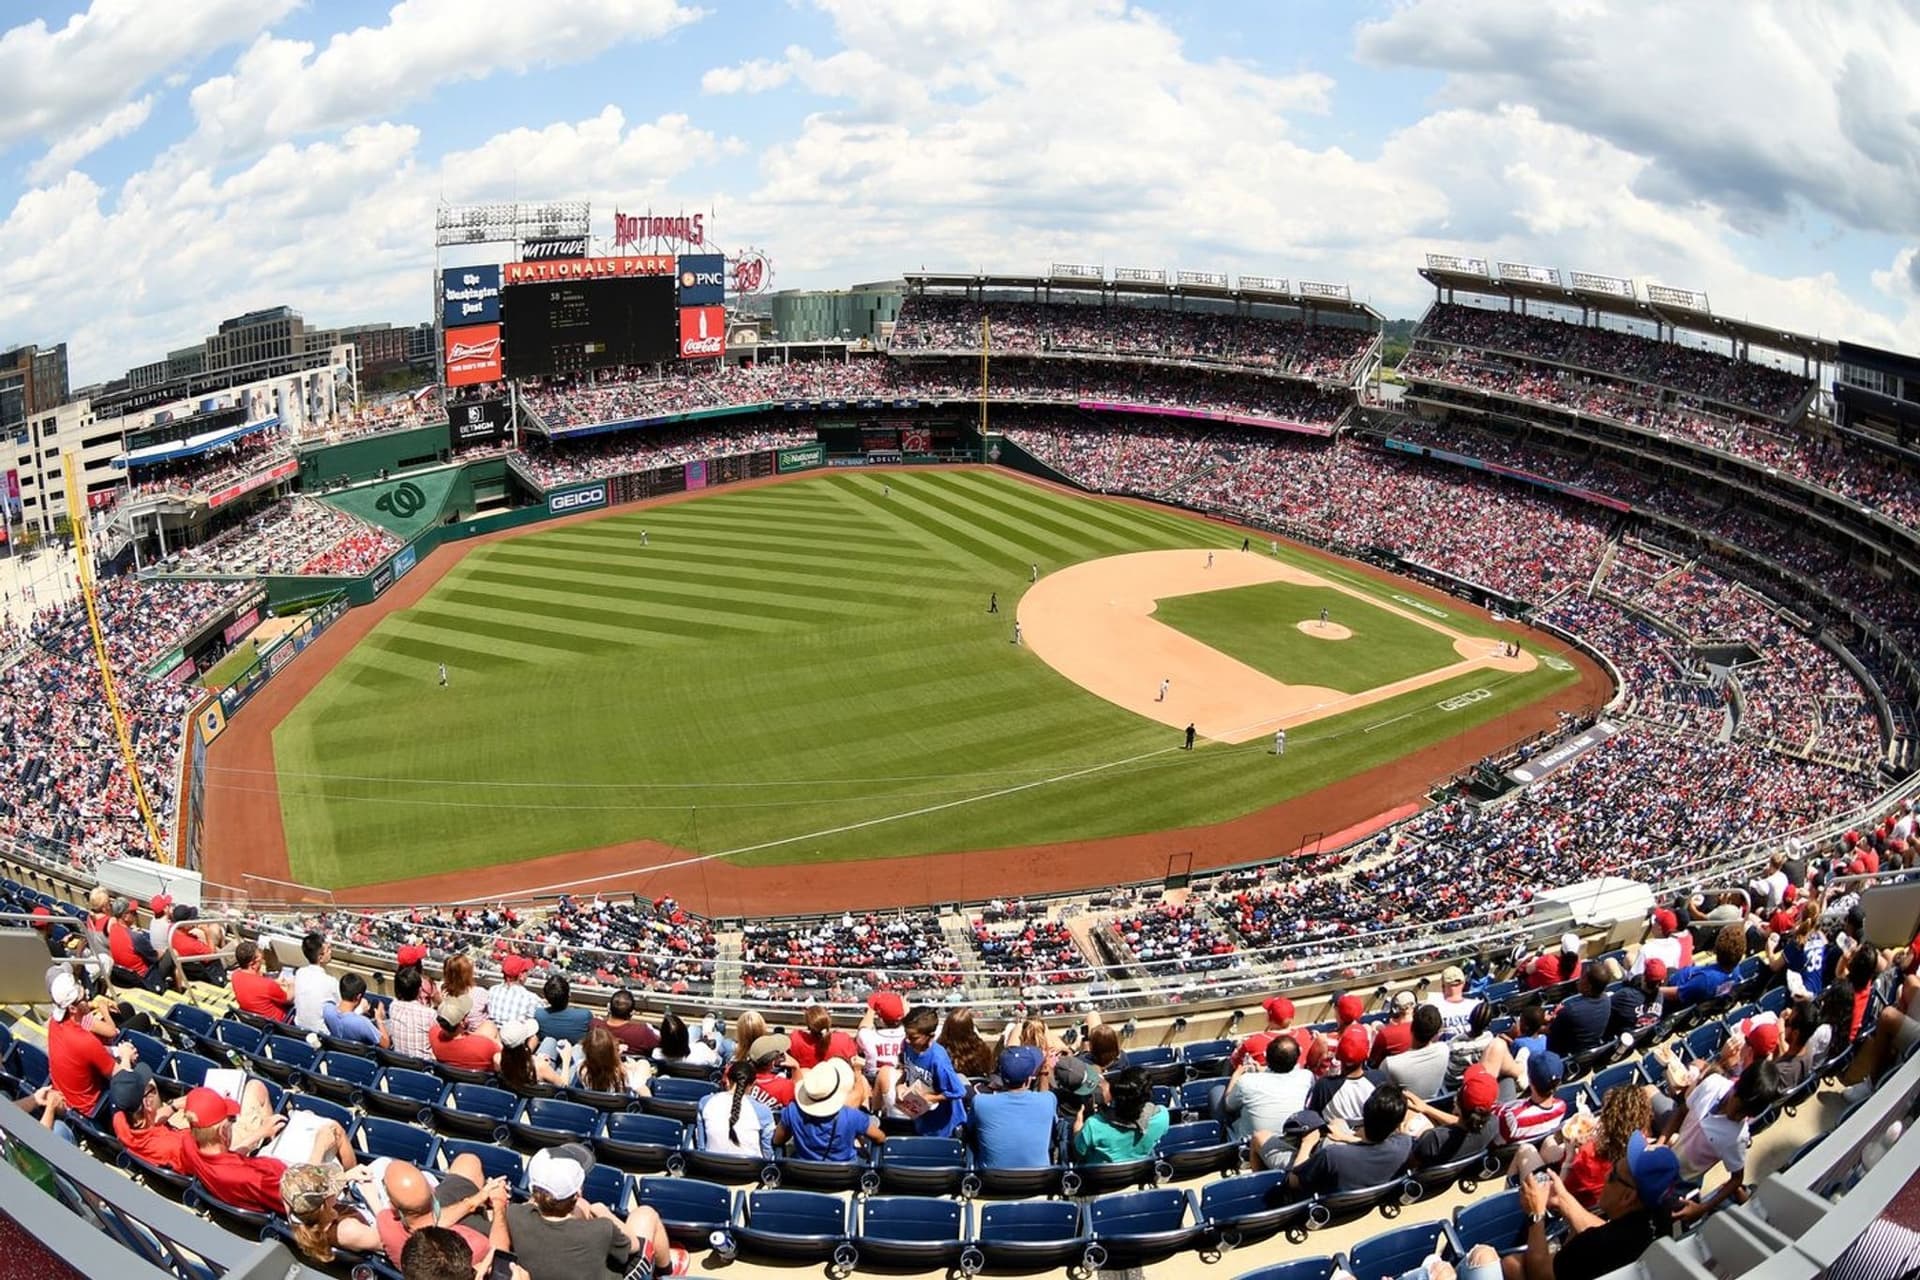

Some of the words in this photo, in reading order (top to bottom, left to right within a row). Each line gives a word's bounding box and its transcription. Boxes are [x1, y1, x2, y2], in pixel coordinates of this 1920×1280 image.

[615, 213, 704, 247] NATIONALS
[511, 261, 616, 278] NATIONALS
[624, 259, 667, 271] PARK
[463, 274, 480, 285] The
[697, 273, 723, 285] PNC
[446, 288, 498, 300] Washington
[552, 489, 603, 509] GEICO
[1435, 688, 1492, 711] GEICO
[875, 1043, 902, 1057] WER
